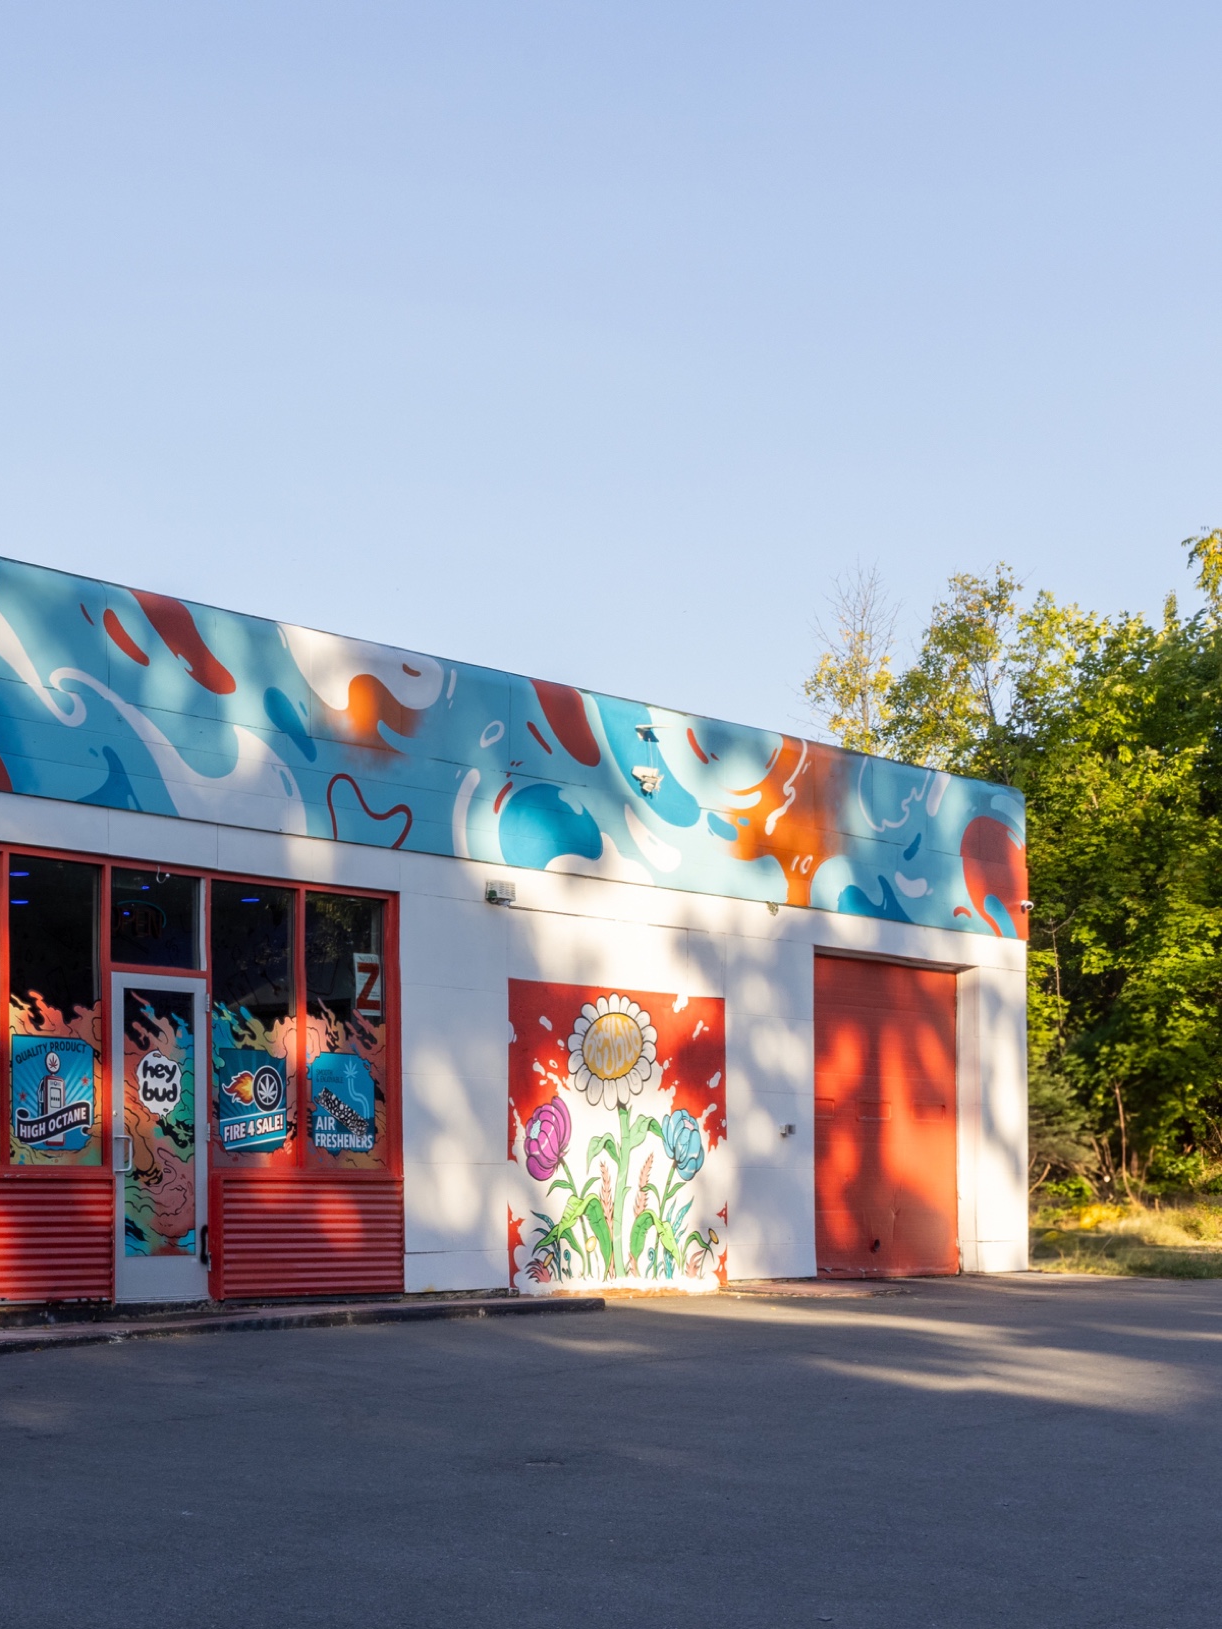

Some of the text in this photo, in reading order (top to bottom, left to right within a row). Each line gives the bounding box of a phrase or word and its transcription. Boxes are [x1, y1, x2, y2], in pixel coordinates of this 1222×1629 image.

[356, 961, 381, 1010] Z
[15, 1041, 87, 1064] QUALITY PRODUCT
[142, 1060, 177, 1083] hey
[142, 1080, 178, 1102] bud
[19, 1107, 87, 1139] HIGH OCTANE
[224, 1114, 284, 1142] FIRE 4 SALE!
[315, 1116, 336, 1131] AIR
[315, 1133, 374, 1149] FRESHENERS
